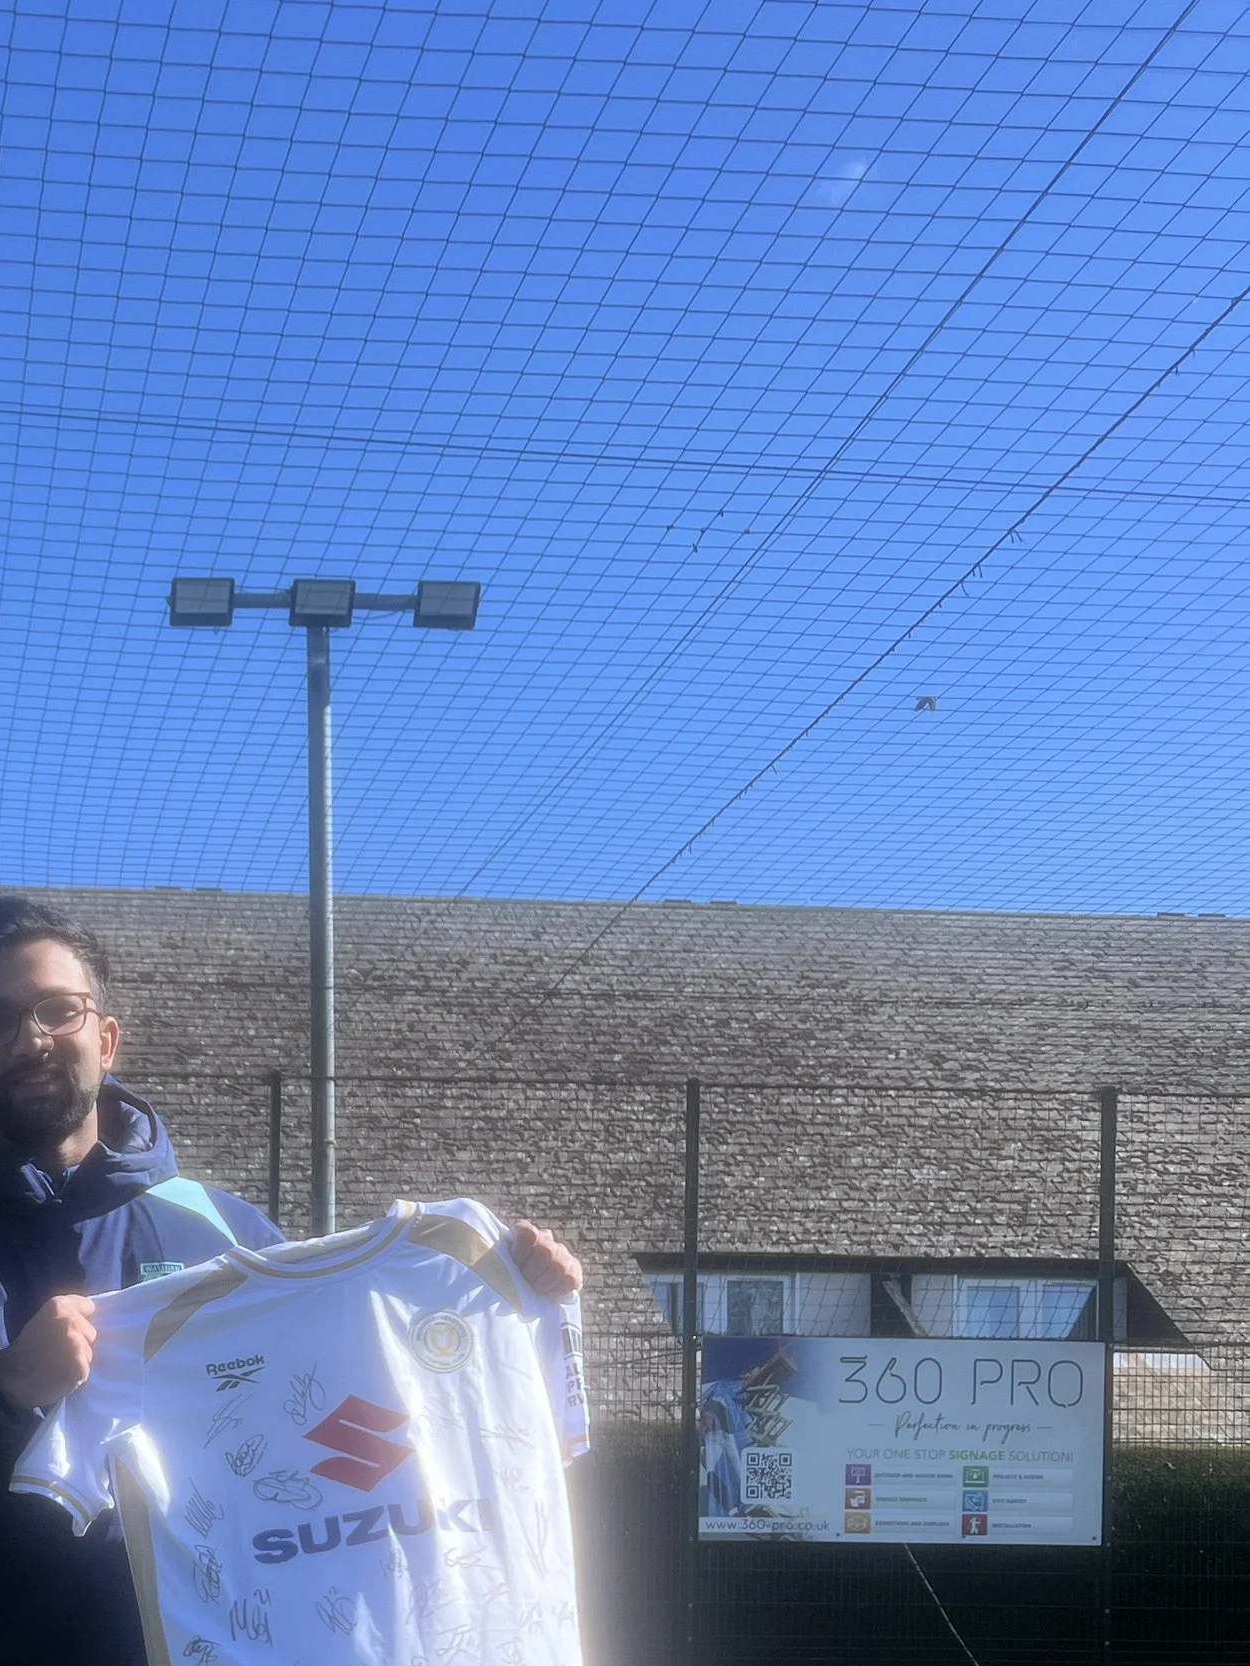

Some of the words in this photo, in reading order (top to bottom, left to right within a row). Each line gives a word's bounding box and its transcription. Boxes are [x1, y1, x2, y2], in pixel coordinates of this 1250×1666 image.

[206, 1354, 265, 1376] Reebok
[838, 1355, 943, 1405] 360
[971, 1357, 1083, 1408] PRO
[894, 1410, 960, 1441] Perfection
[966, 1423, 981, 1432] in
[983, 1423, 1031, 1445] progress
[846, 1448, 880, 1460] YOUR
[883, 1448, 910, 1460] ONE
[914, 1449, 946, 1461] STOP
[949, 1449, 1006, 1461] SIGNAGE
[252, 1497, 494, 1565] SUZUKI
[705, 1519, 830, 1531] www.360-pro.co.uk
